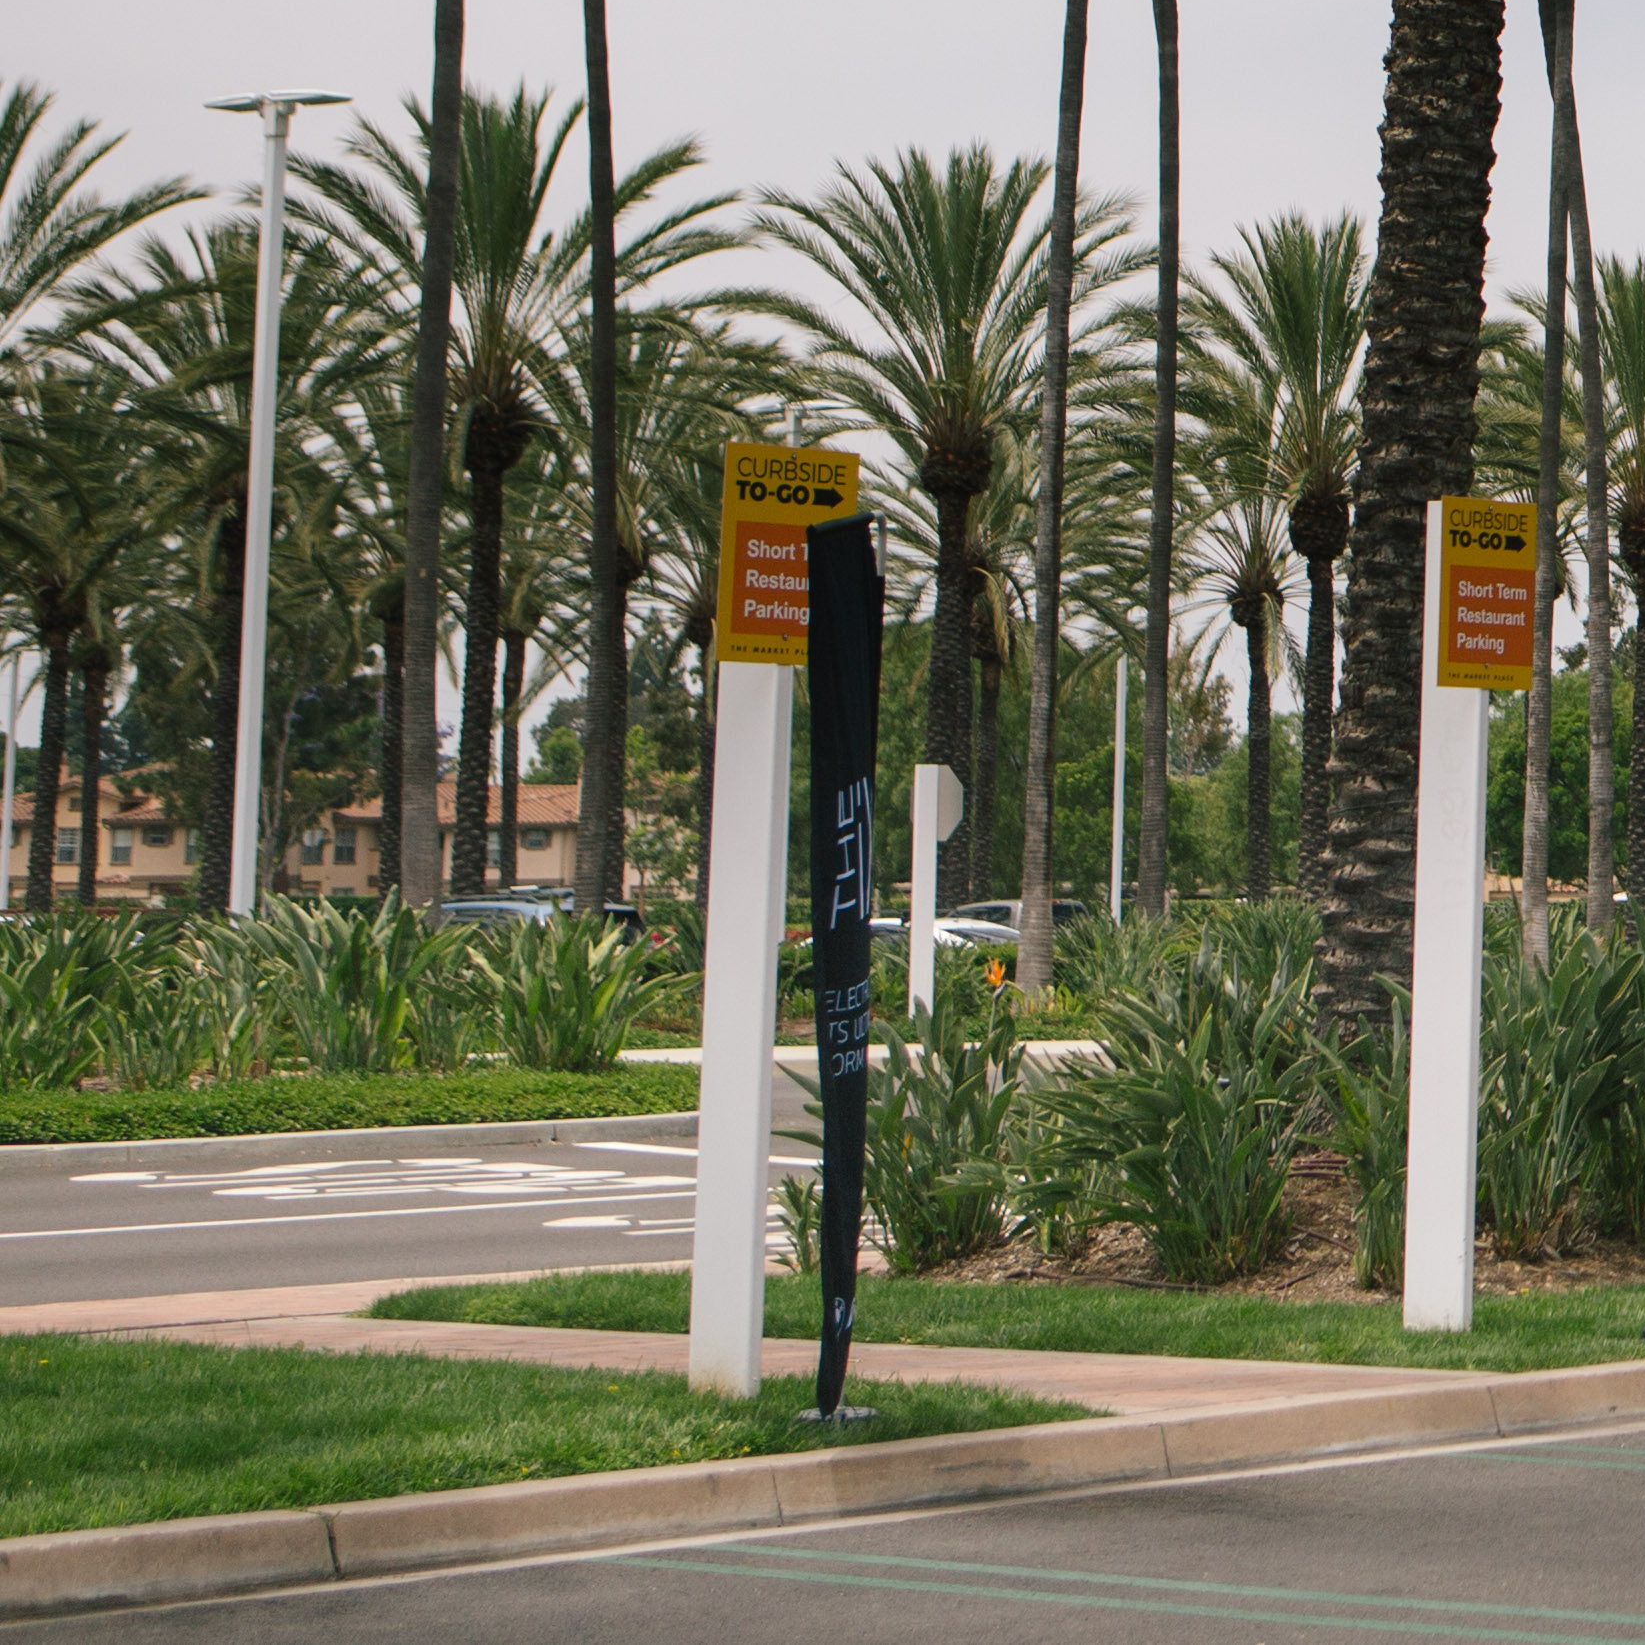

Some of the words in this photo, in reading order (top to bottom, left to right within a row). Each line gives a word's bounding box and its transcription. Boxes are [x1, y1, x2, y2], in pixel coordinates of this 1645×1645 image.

[737, 457, 847, 486] CURBSIDE
[735, 480, 810, 505] TO-GO
[1450, 509, 1528, 533] CURBSIDE
[747, 539, 796, 561] Short
[1449, 529, 1502, 550] TO-GO
[745, 569, 809, 591] Restau
[1458, 580, 1493, 599] Short
[1496, 582, 1527, 601] Term
[743, 599, 809, 626] Parking
[1457, 606, 1525, 626] Restaurant
[731, 644, 748, 653] THE
[753, 646, 790, 655] MARKET
[1457, 632, 1505, 654] Parking
